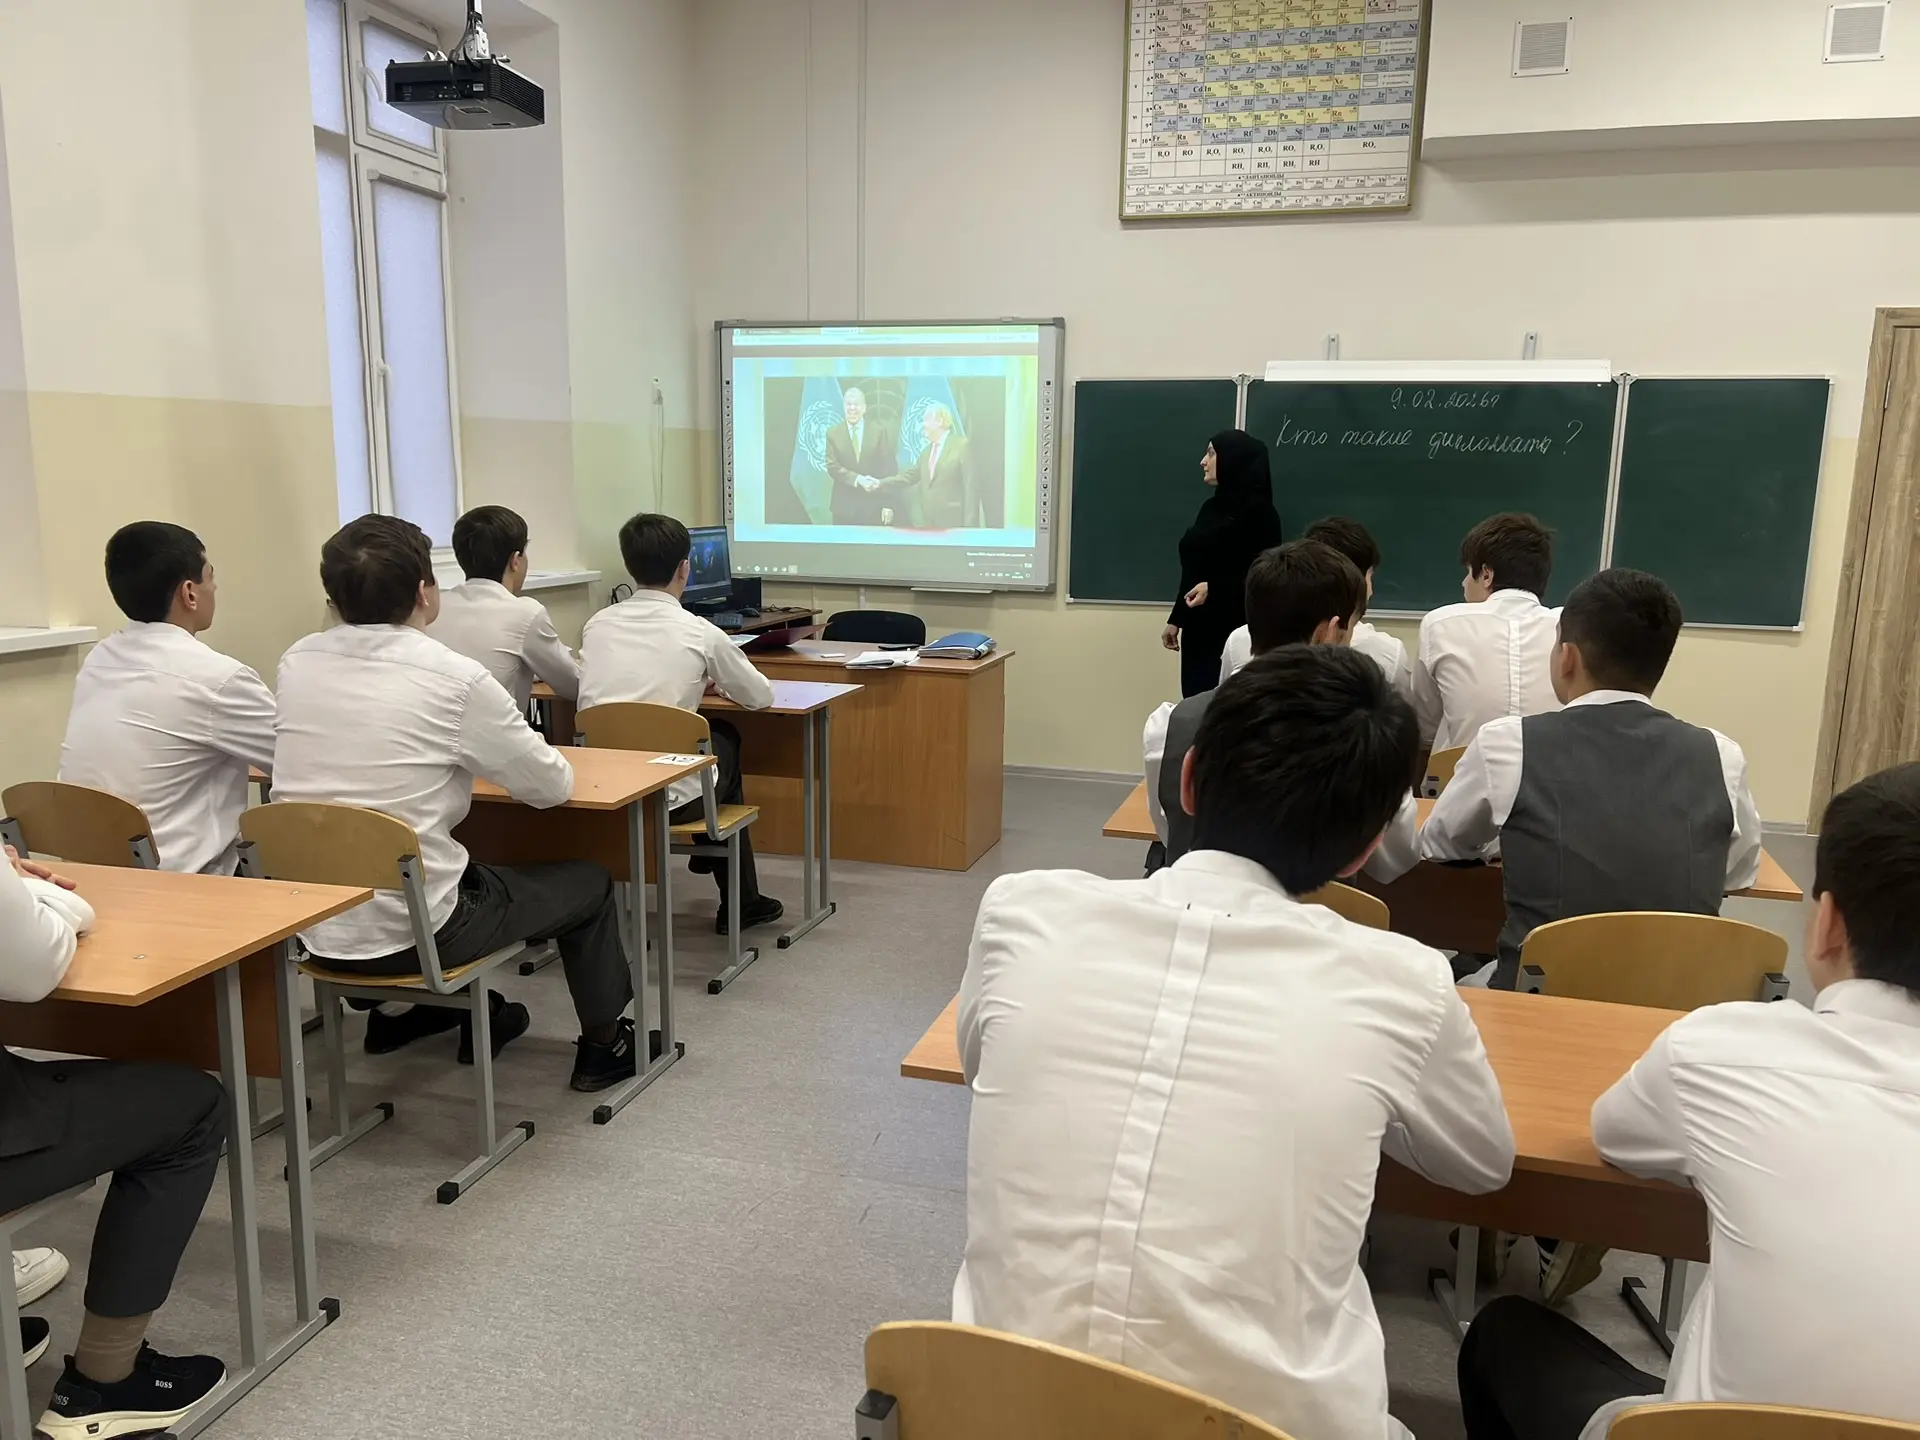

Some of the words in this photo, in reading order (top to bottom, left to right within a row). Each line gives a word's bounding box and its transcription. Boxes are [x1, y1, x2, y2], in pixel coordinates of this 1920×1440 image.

[1275, 414, 1328, 448] Кто
[1340, 427, 1413, 447] такие
[155, 1379, 173, 1389] BOSS
